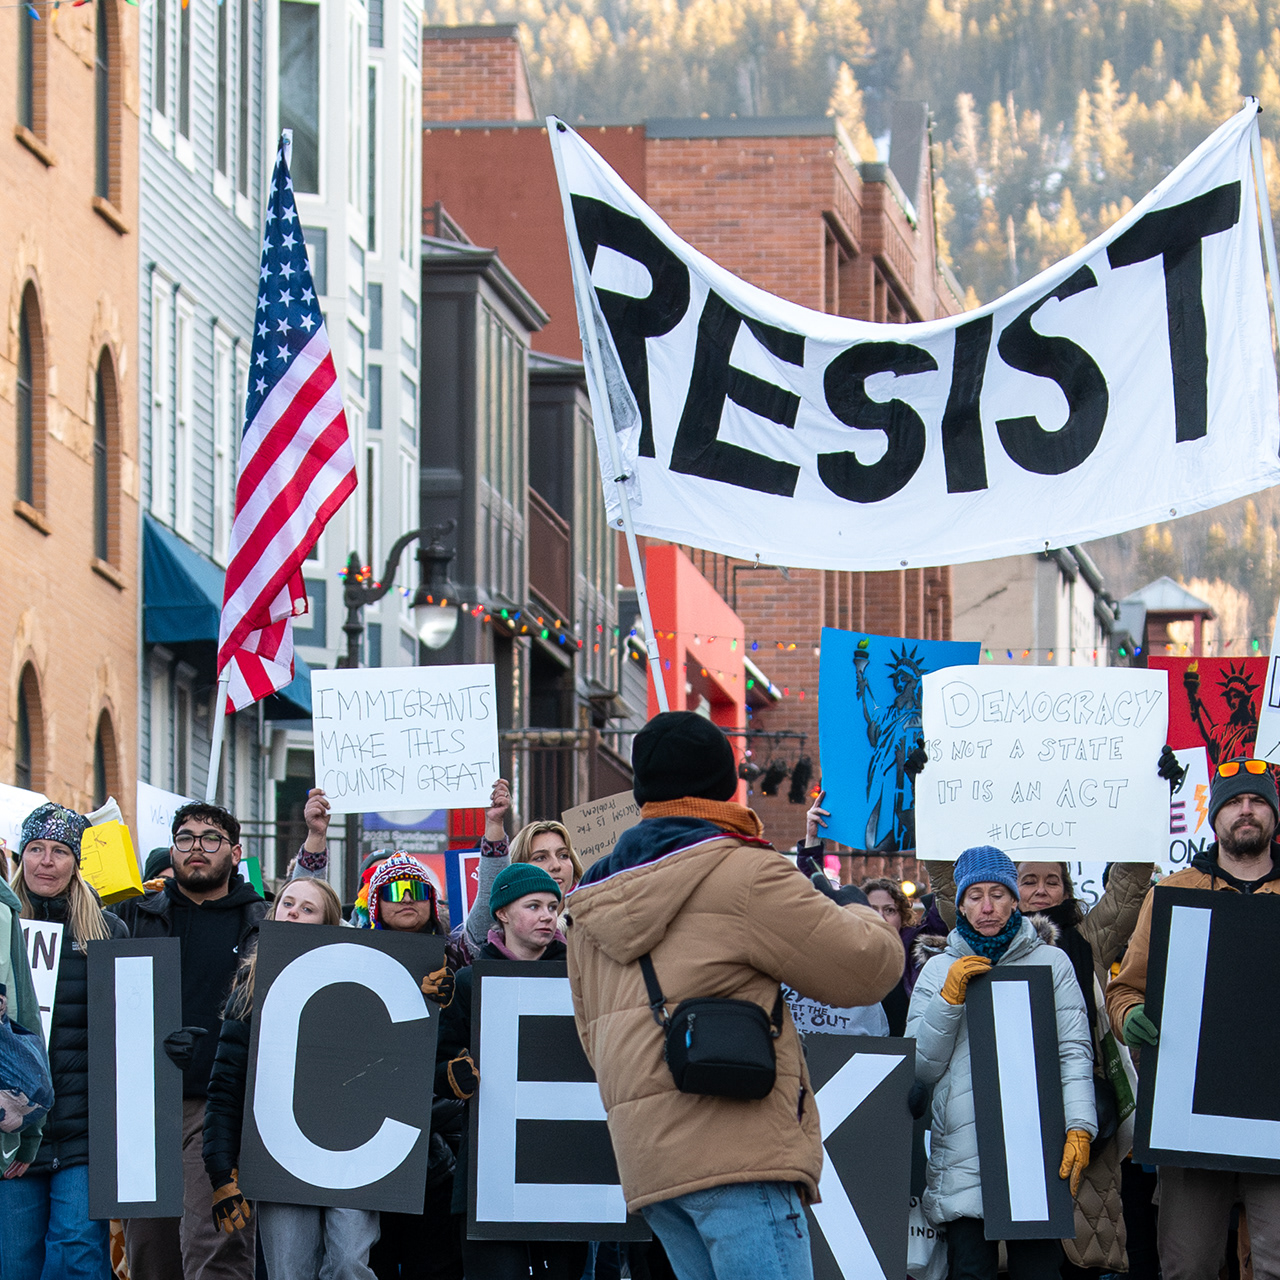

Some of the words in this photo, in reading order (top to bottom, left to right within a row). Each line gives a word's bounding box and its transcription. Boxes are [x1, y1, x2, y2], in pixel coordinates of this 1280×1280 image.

[570, 181, 1241, 504] RESIST
[315, 684, 490, 722] IMMIGRANTS
[941, 681, 1162, 728] DEMOCRACY
[321, 730, 387, 766] MAKE
[400, 728, 465, 758] THIS
[951, 739, 993, 761] NOT
[1009, 738, 1025, 759] A
[1037, 736, 1124, 762] STATE
[323, 763, 406, 800] COUNTRY
[937, 779, 963, 805] IT
[972, 779, 994, 802] IS
[1010, 780, 1042, 804] AN
[1056, 779, 1129, 808] ACT
[363, 830, 391, 842] 2026
[987, 821, 1077, 842] #ICEOUT
[807, 1005, 829, 1016] THE
[810, 1014, 851, 1029] OUT
